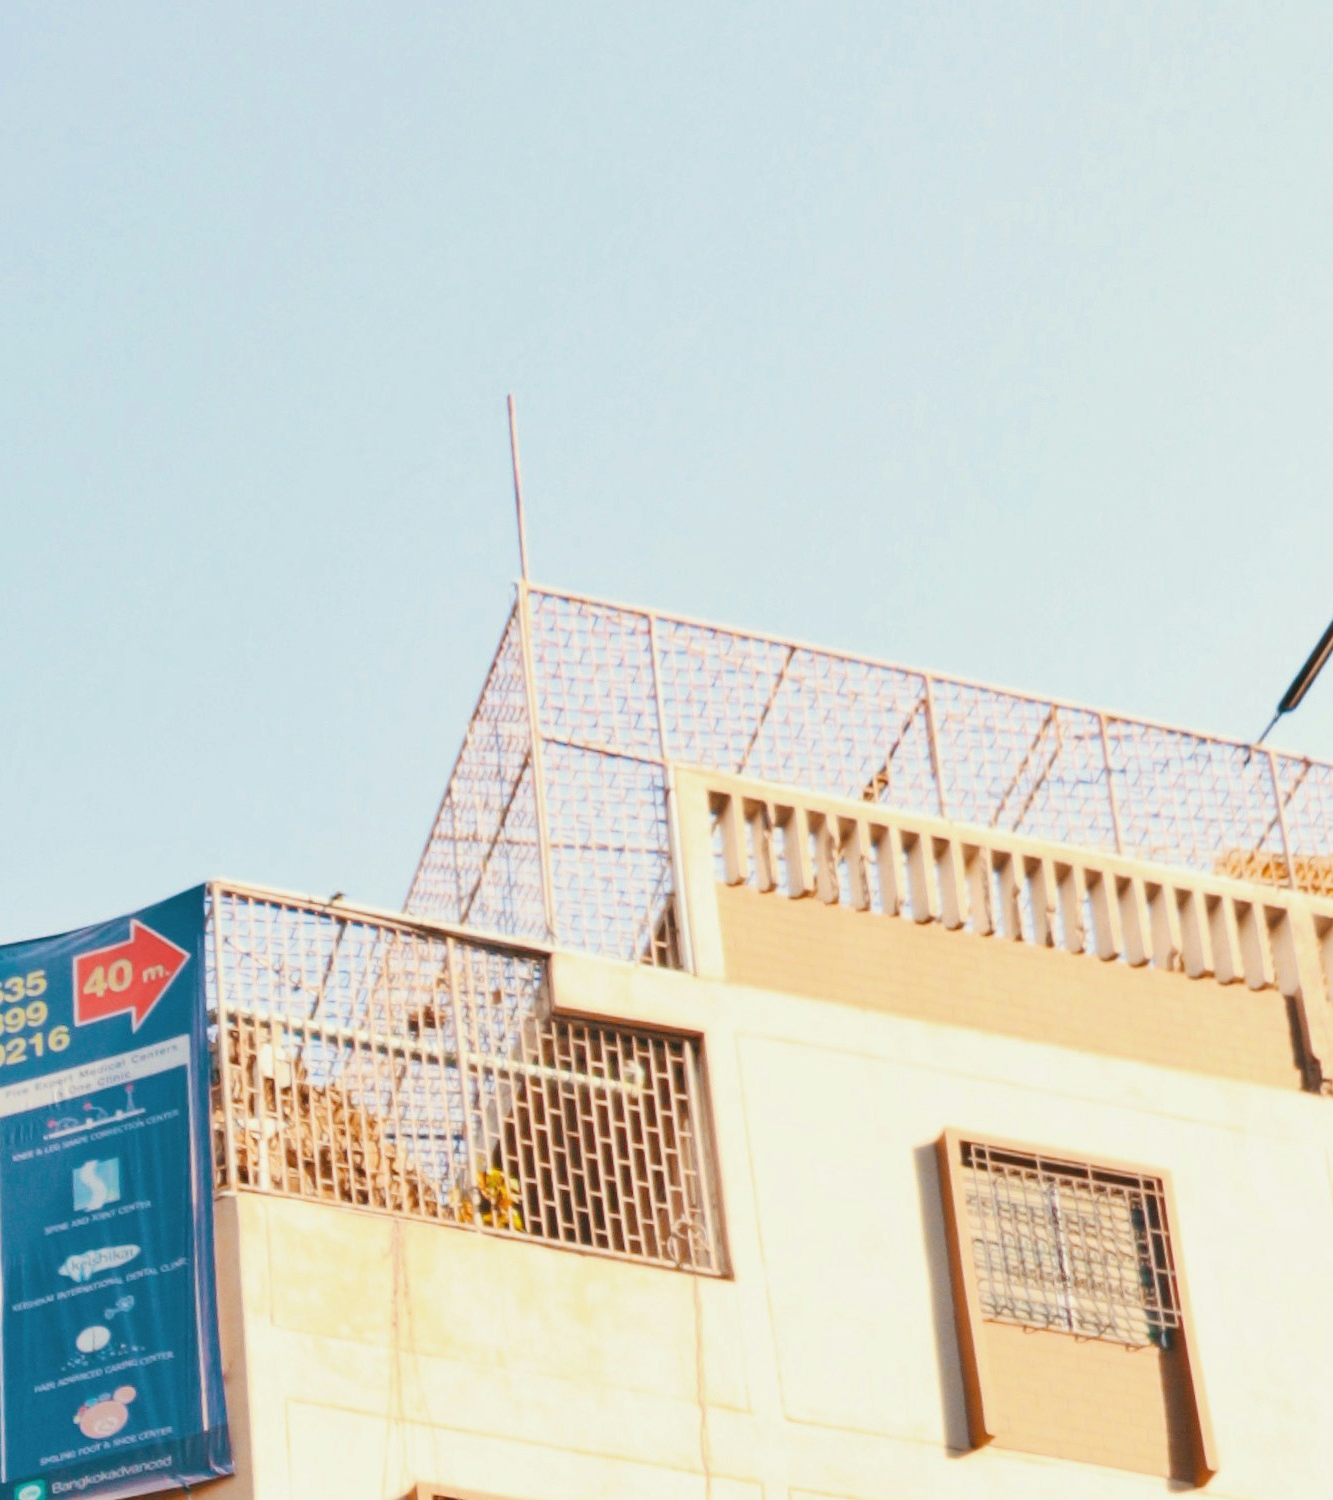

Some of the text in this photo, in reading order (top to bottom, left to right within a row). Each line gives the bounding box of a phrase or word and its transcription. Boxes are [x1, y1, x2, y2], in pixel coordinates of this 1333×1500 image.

[83, 959, 171, 997] 40 m.
[130, 1044, 179, 1064] Centers
[51, 1455, 172, 1495] Bangkokadvanced
